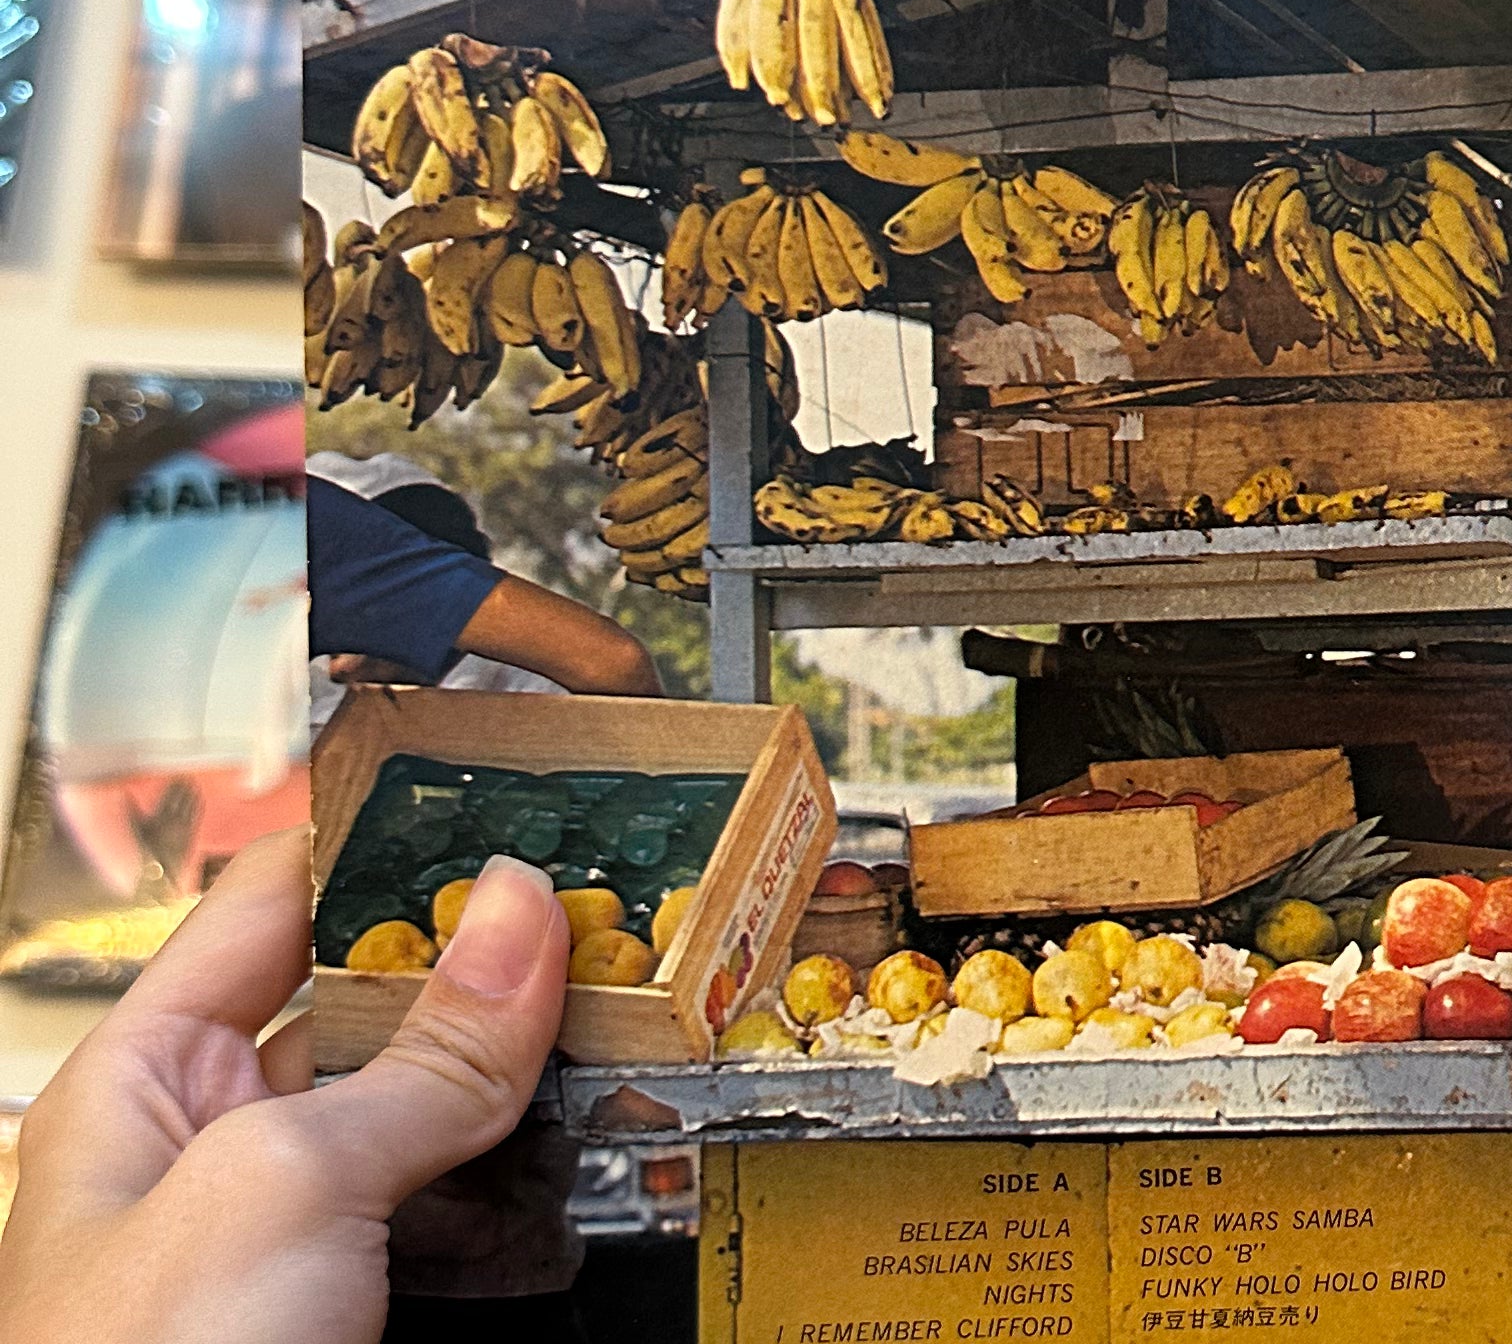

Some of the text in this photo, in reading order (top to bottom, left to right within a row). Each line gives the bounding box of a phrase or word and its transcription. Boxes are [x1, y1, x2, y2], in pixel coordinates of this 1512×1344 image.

[983, 1172, 1070, 1194] SIDE A
[1138, 1166, 1223, 1189] SIDE B
[899, 1218, 1072, 1243] BELEZA PULA
[1140, 1207, 1375, 1235] STAR WARS SAMBA
[864, 1250, 1075, 1276] BRASILIAN SKIES
[1141, 1244, 1213, 1268] DISCO
[983, 1282, 1075, 1306] NIGHTS
[1141, 1268, 1447, 1300] FUNKY HOLO HOLO BIRD
[776, 1315, 1074, 1344] I REMEMBER CLIFFORD
[1141, 1304, 1321, 1333] 伊豆甘夏納豆売り
